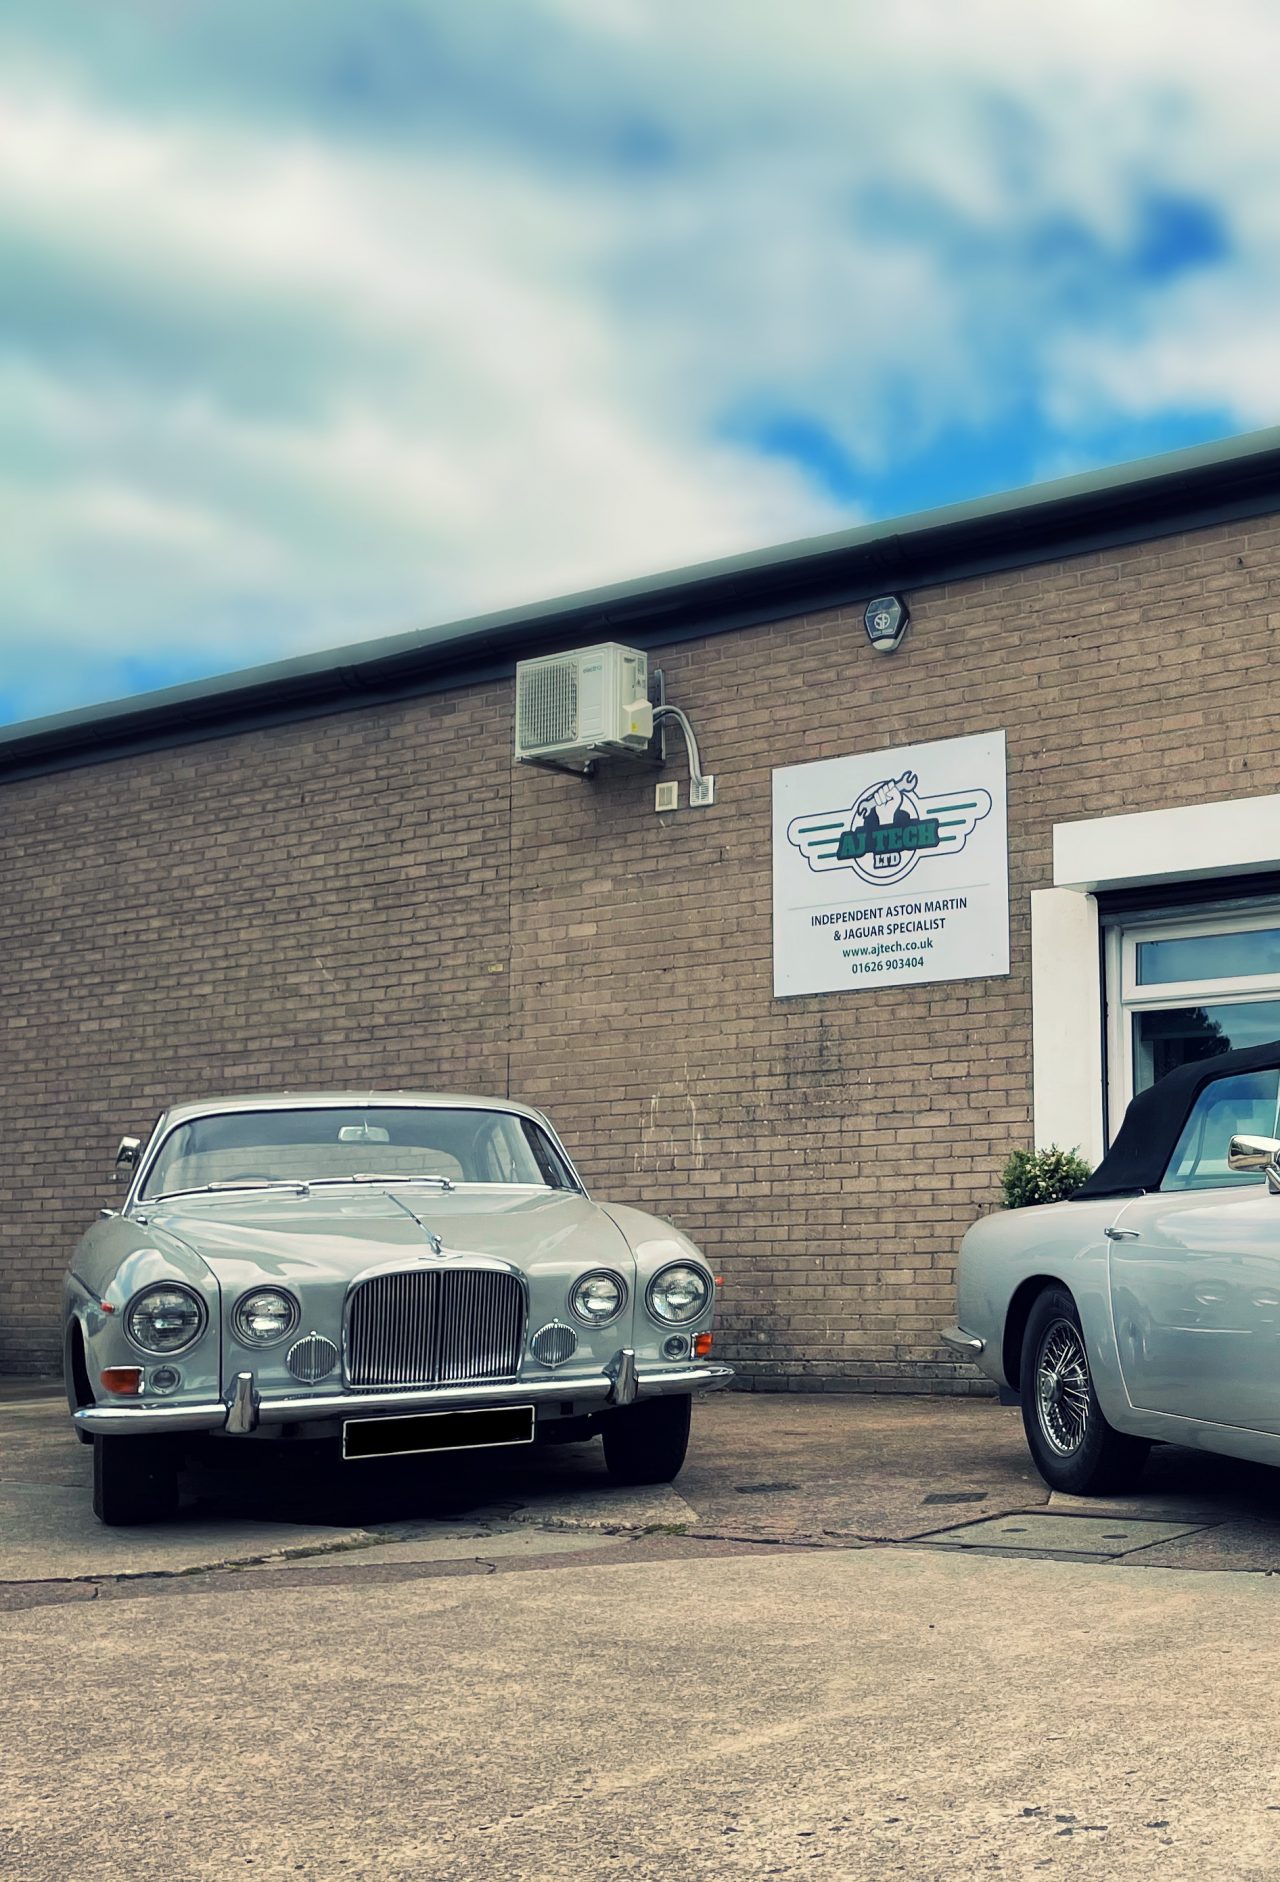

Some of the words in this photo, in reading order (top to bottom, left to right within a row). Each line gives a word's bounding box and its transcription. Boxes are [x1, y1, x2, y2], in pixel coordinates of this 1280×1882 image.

[841, 831, 867, 857] AJ
[873, 822, 937, 852] TECH
[875, 852, 900, 868] LTD
[811, 907, 883, 927] INDEPENDENT
[886, 903, 922, 918] ASTON
[924, 897, 967, 913] MARTIN
[833, 930, 842, 941] &
[843, 925, 884, 941] JAGUAR
[886, 917, 946, 935] SPECIALIST
[842, 937, 934, 958] www.ajtech.co.uk
[852, 961, 883, 974] 01626
[886, 956, 924, 971] 903404
